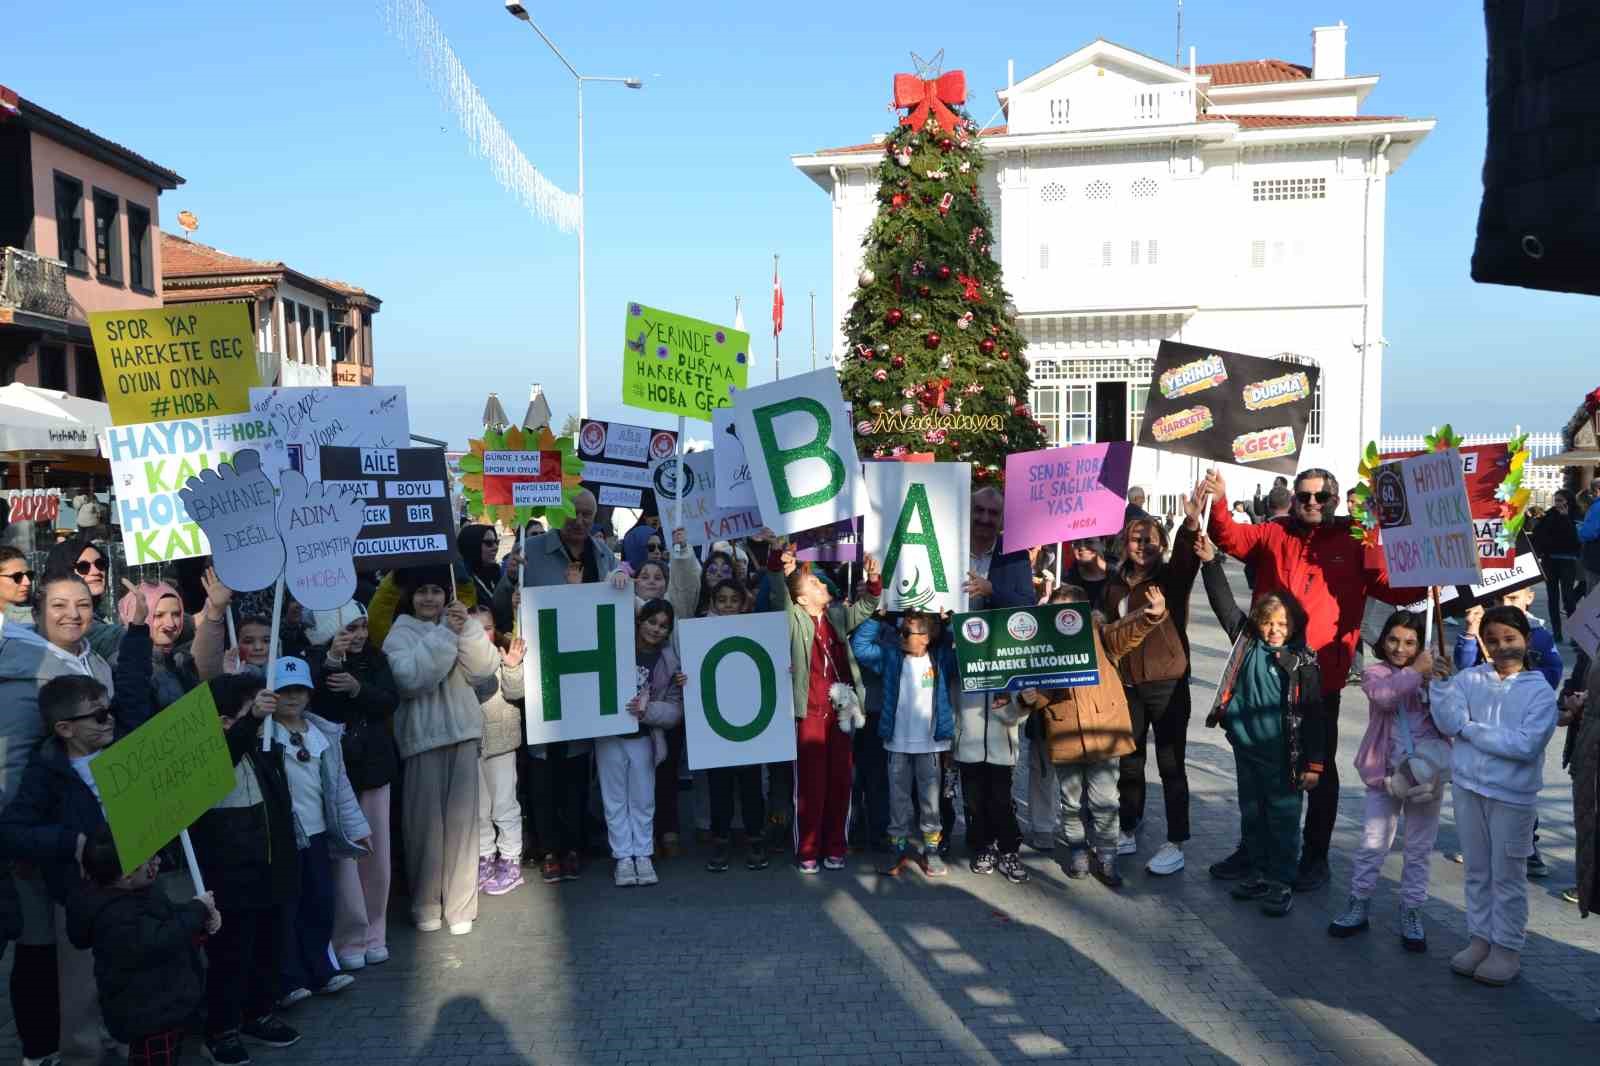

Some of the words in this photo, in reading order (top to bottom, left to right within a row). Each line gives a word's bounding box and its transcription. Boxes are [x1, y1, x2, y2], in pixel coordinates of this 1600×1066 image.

[106, 318, 152, 341] SPOR
[165, 315, 197, 337] YAP
[111, 341, 203, 368] HAREKETE
[637, 360, 713, 392] HAREKETE
[678, 353, 735, 382] DURMA
[118, 371, 161, 394] OYUN
[170, 367, 220, 389] OYNA
[151, 393, 219, 417] #HOBA
[872, 408, 1004, 433] Mudanya
[1159, 411, 1206, 435] HAREKETE
[752, 396, 846, 514] B
[1245, 432, 1287, 454] GEÇ!
[364, 450, 397, 472] AİLE
[518, 465, 539, 473] OYUN
[1029, 464, 1054, 482] SEN
[1056, 461, 1071, 478] DE
[193, 481, 271, 522] BAHANE
[398, 483, 431, 496] BOYU
[290, 504, 339, 529] ADIM
[880, 483, 949, 593] A
[538, 604, 618, 722] H
[967, 659, 1027, 673] MÜTAREKE
[1030, 653, 1090, 668] İLKOKULU
[997, 644, 1054, 657] MUDANYA
[700, 636, 777, 743] O
